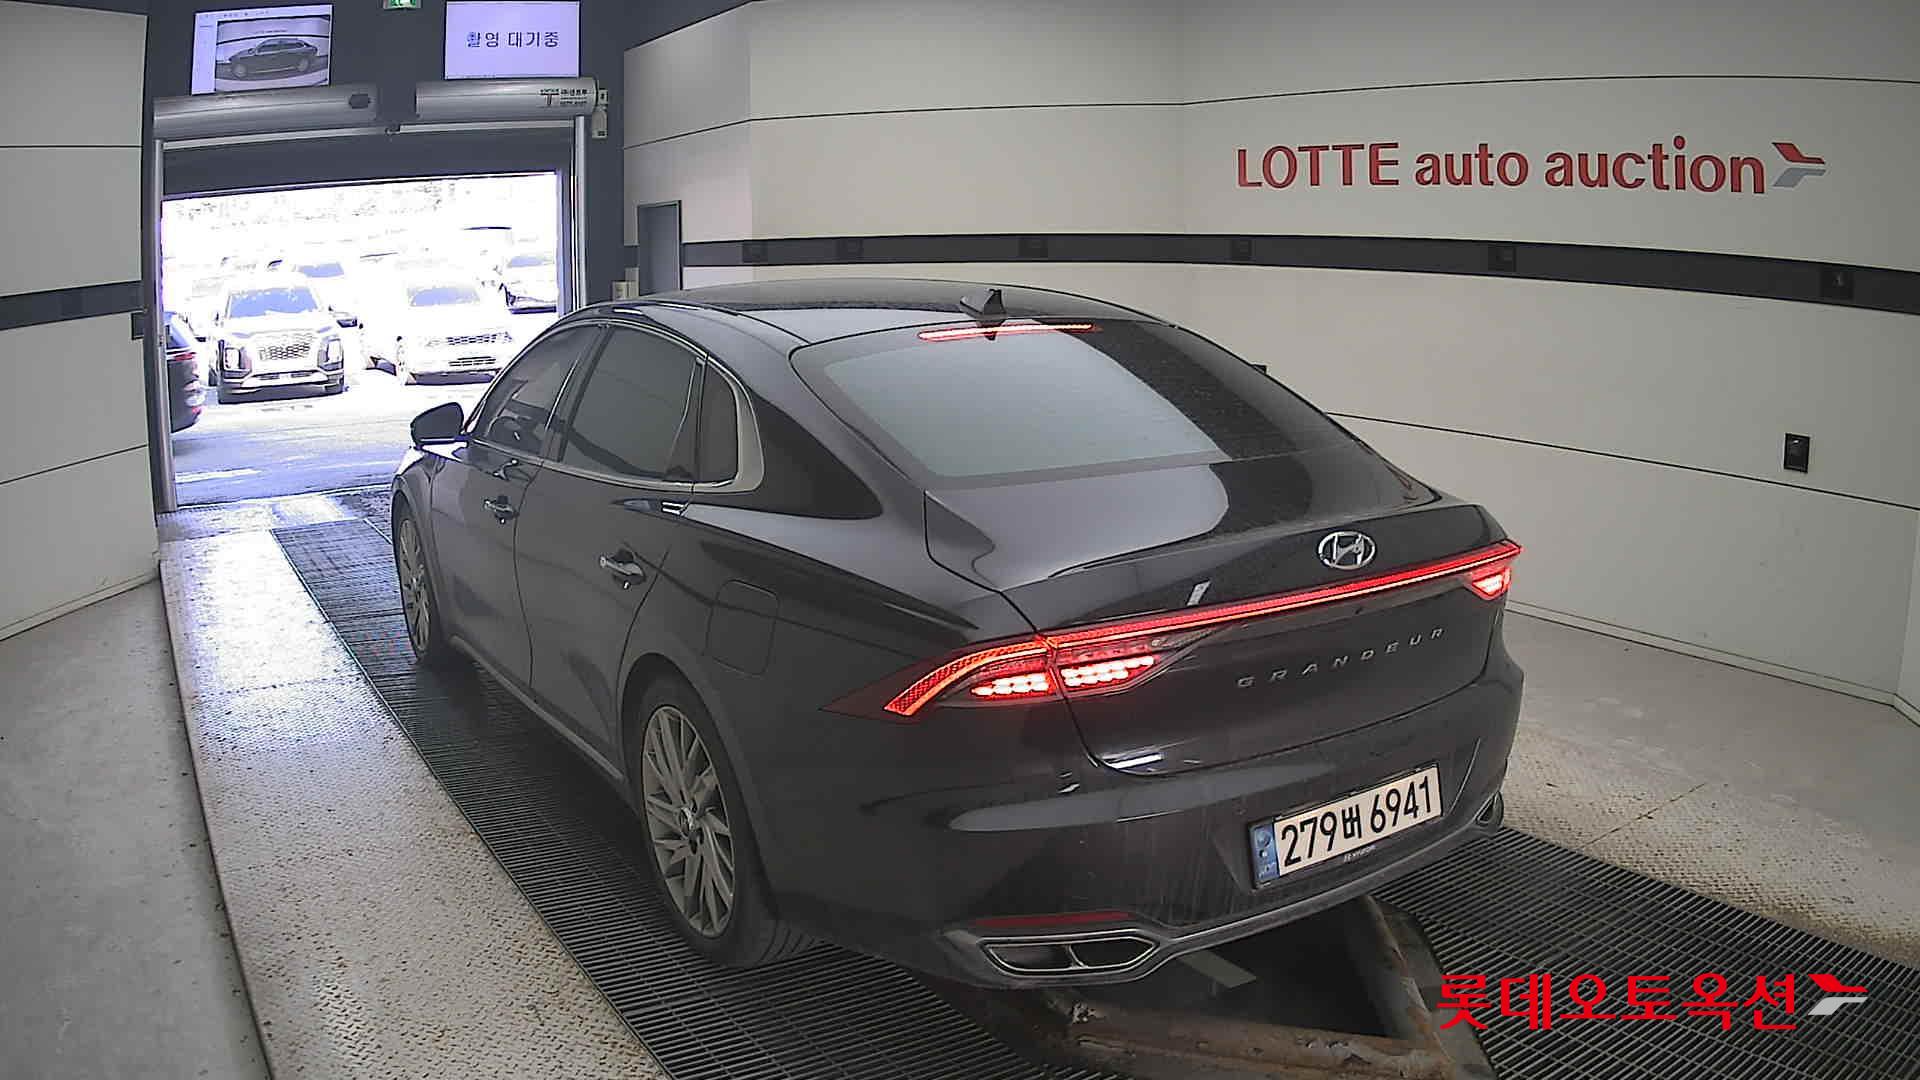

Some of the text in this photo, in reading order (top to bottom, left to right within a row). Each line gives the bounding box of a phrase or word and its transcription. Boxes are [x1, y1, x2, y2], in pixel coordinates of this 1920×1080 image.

[508, 31, 559, 48] 대기중
[1236, 135, 1766, 194] LOTTE auto auction
[1237, 627, 1444, 688] GRANDEUR
[1281, 775, 1432, 867] 279버 6941
